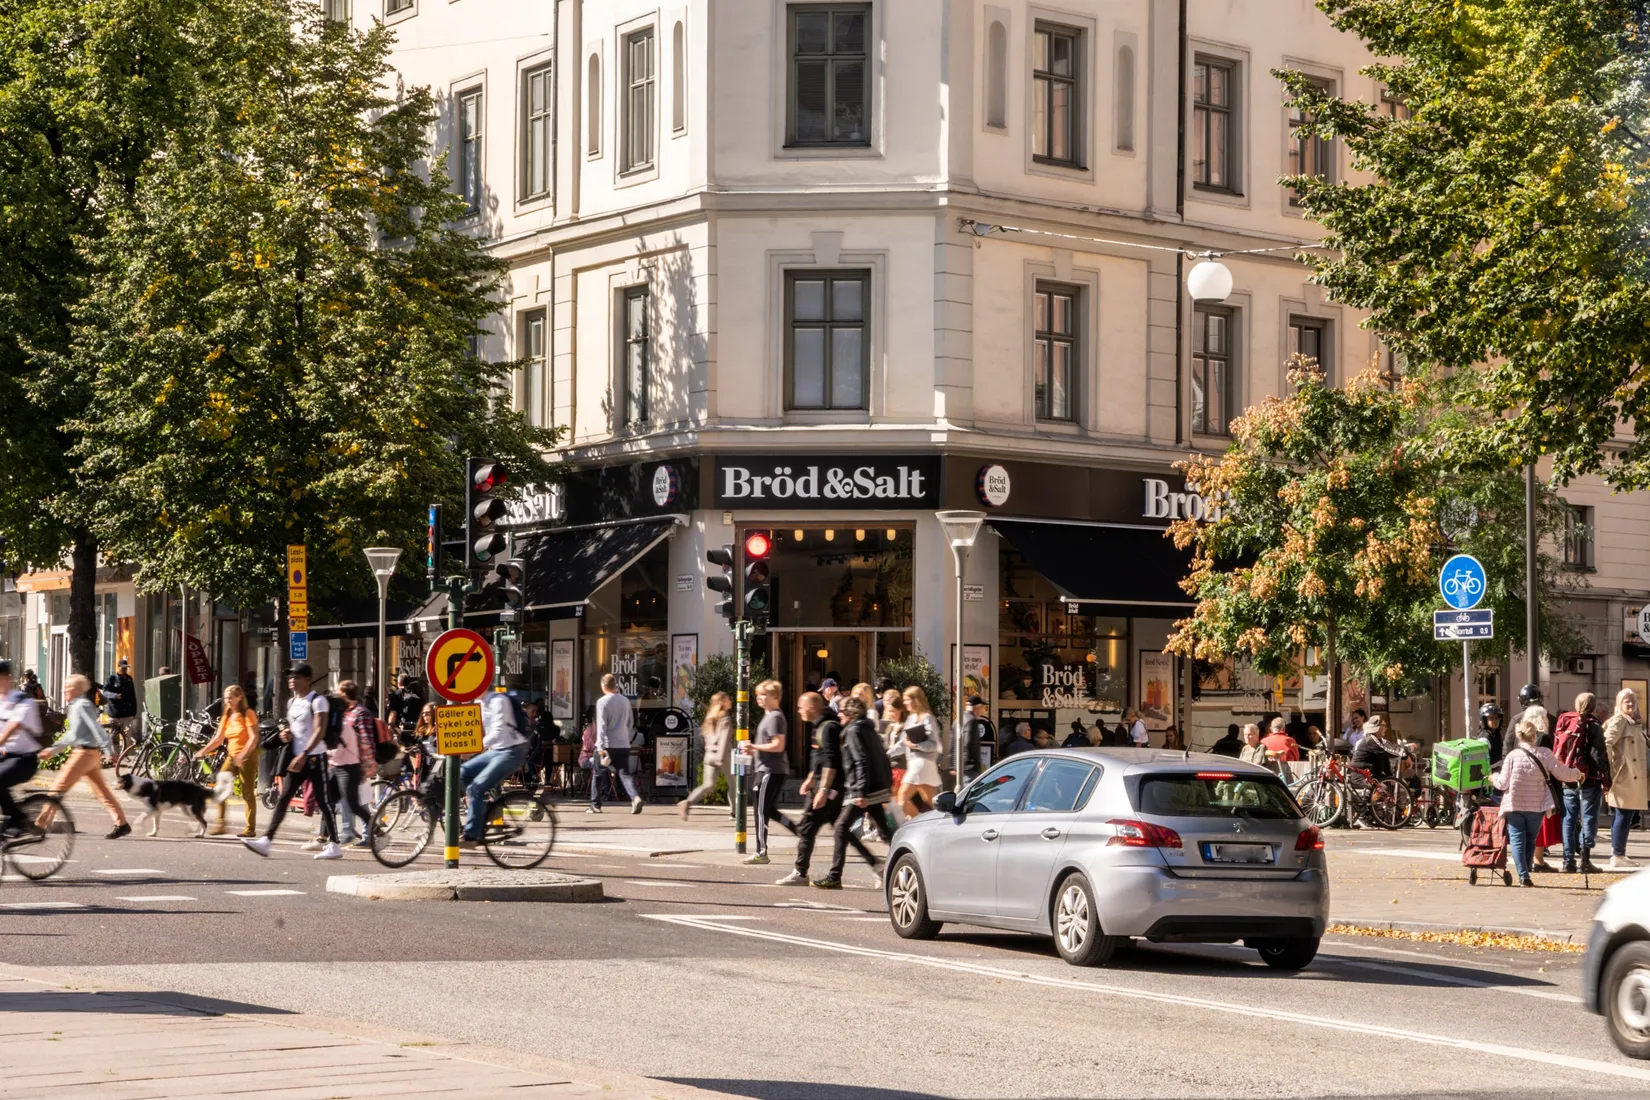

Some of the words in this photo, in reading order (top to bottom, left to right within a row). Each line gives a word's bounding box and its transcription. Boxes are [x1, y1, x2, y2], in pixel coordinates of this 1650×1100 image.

[988, 484, 1006, 493] &Salt
[989, 475, 1006, 485] Bröd
[400, 640, 421, 659] Bröd
[188, 641, 208, 680] ÖPPET
[399, 659, 421, 678] &Salt
[504, 655, 524, 675] Salt
[611, 653, 638, 675] Bröd
[1042, 664, 1084, 686] Bröd
[1041, 687, 1085, 709] &Salt
[438, 709, 465, 719] Gäller
[467, 708, 476, 717] ej
[438, 720, 462, 730] cykel
[464, 719, 480, 727] och
[443, 729, 473, 739] moped
[444, 740, 468, 748] klass
